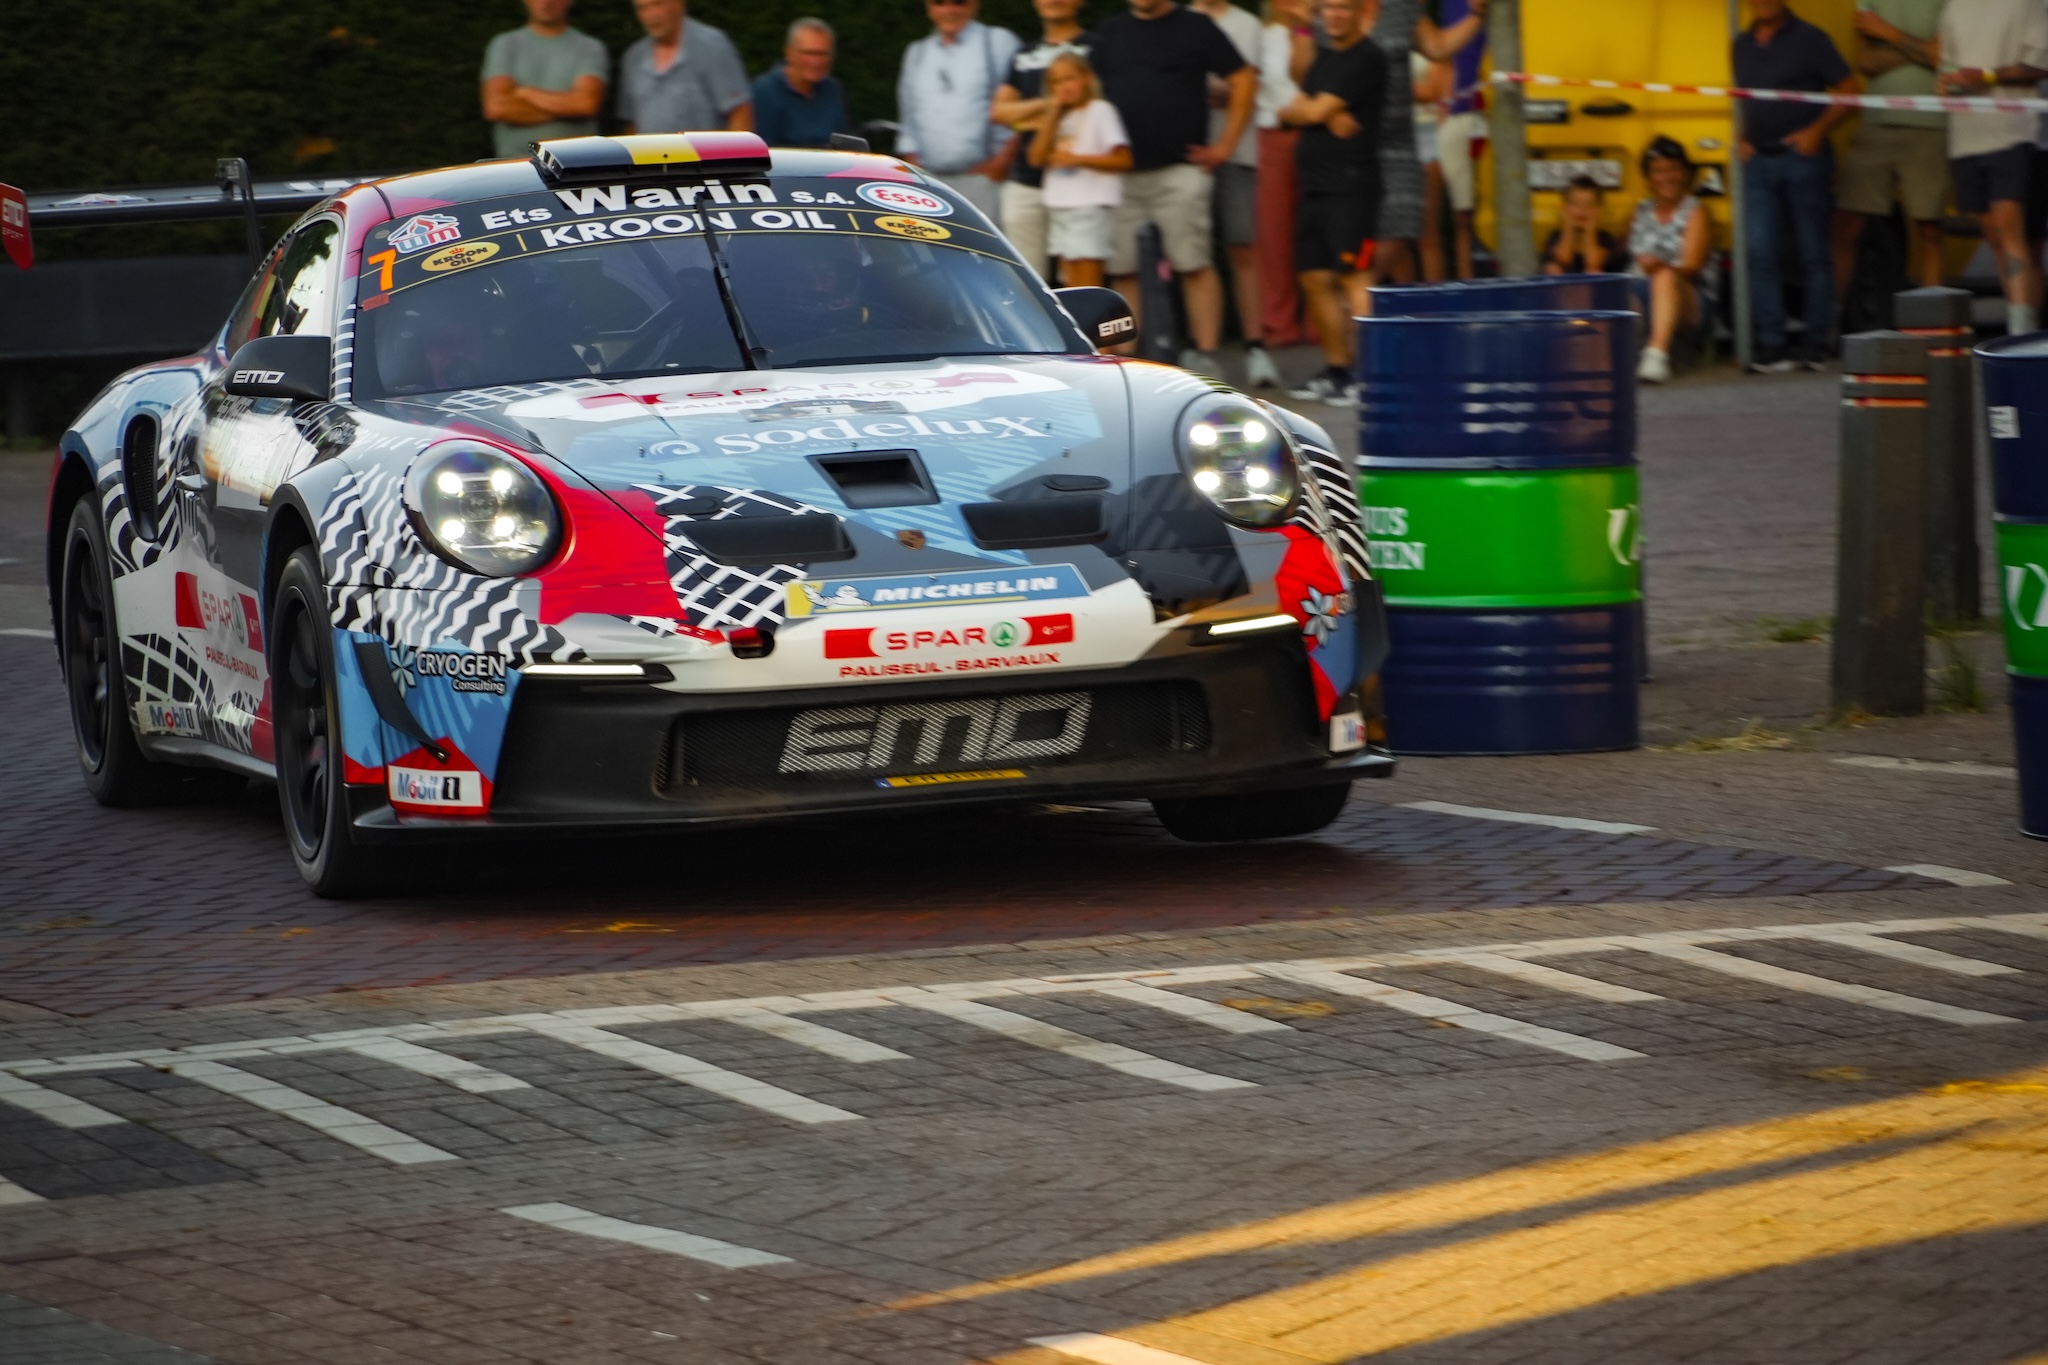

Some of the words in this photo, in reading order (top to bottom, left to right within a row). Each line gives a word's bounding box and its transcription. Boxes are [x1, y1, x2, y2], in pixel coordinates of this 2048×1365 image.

[481, 207, 552, 230] Ets
[555, 180, 778, 216] Warin
[790, 191, 855, 205] S.A.
[541, 211, 737, 248] KROON
[751, 210, 836, 229] OIL
[886, 221, 940, 235] KROON
[903, 228, 927, 237] OIL
[433, 246, 488, 267] KROON
[450, 257, 475, 267] OIL
[367, 249, 397, 291] 7
[687, 383, 858, 400] SPAR
[714, 415, 1051, 456] sodelux
[872, 577, 1058, 602] MICHELIN
[202, 590, 236, 631] SPAR
[886, 627, 986, 650] SPAR
[416, 652, 506, 678] CRYOGEN
[453, 679, 505, 694] Consulting
[150, 705, 186, 730] Mobil
[398, 772, 438, 800] Mobil
[442, 777, 459, 800] 1
